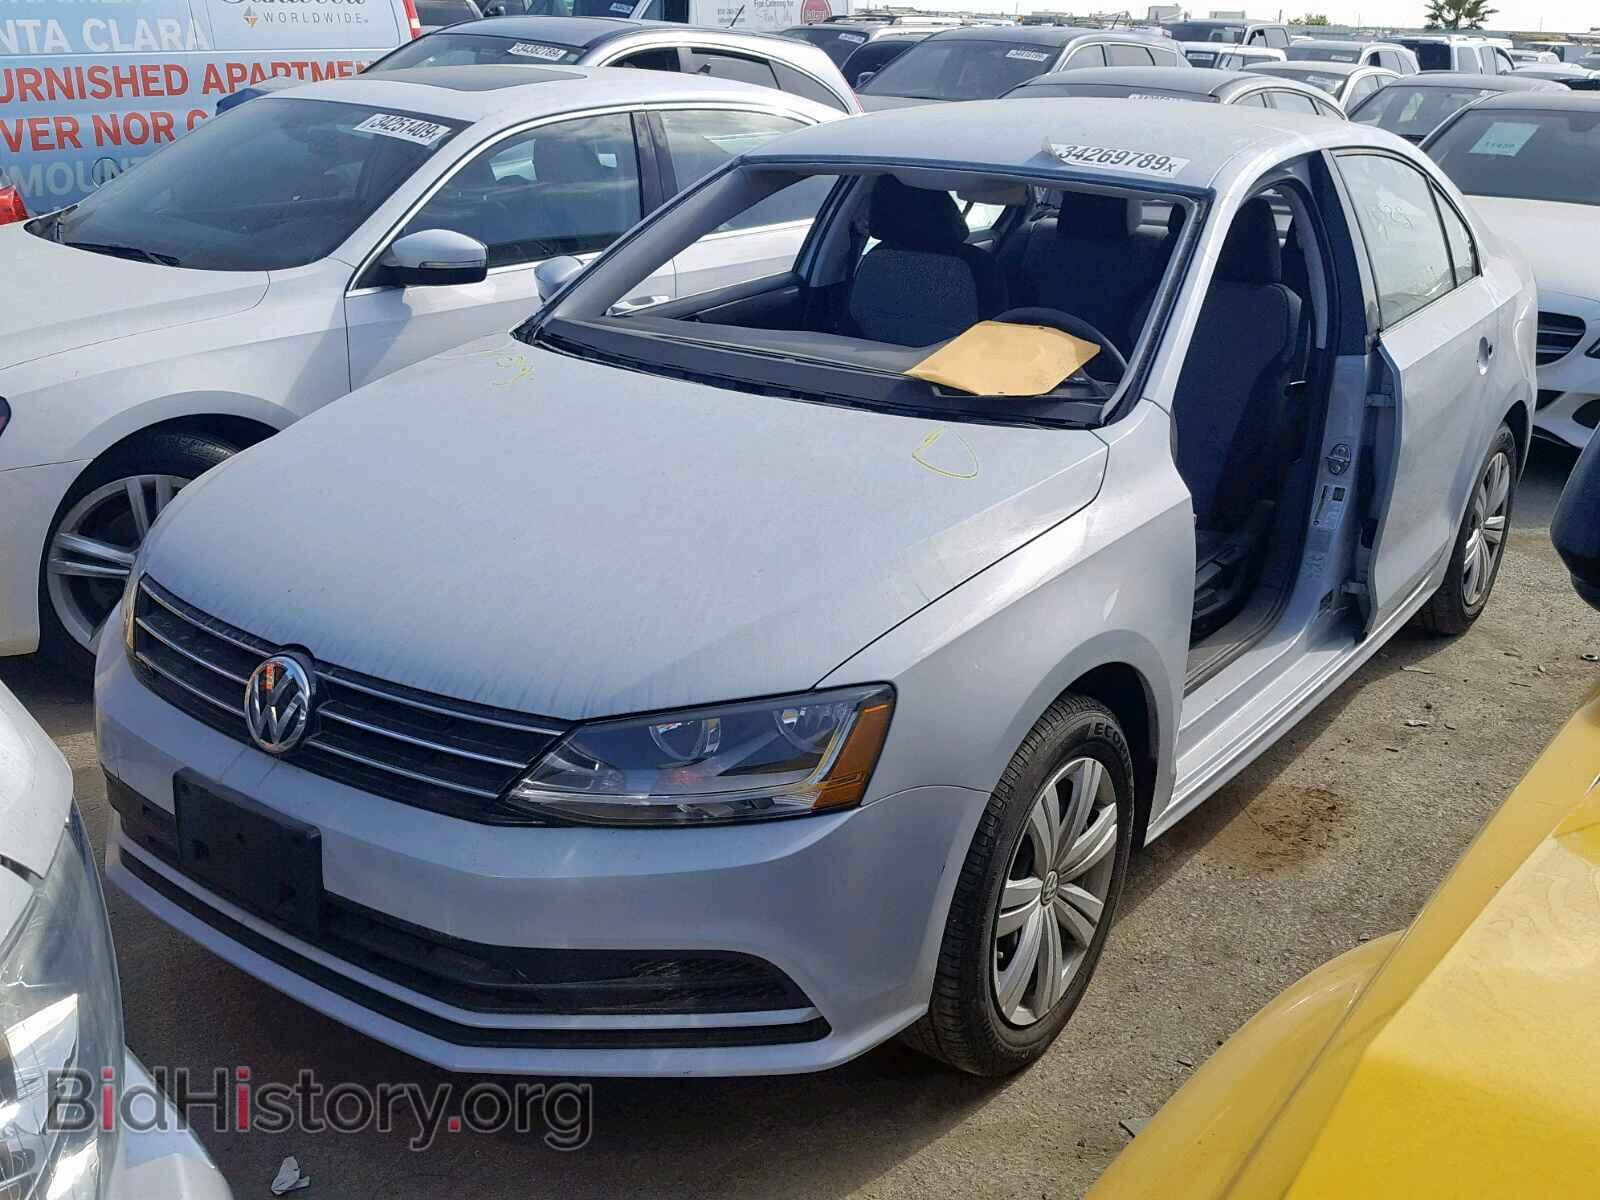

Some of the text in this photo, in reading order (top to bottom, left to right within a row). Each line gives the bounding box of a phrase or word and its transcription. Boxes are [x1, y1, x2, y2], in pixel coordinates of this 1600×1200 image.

[82, 18, 210, 52] CLARA
[264, 12, 362, 24] WORLDWIDE
[0, 115, 82, 152] VER
[92, 112, 176, 147] NOR
